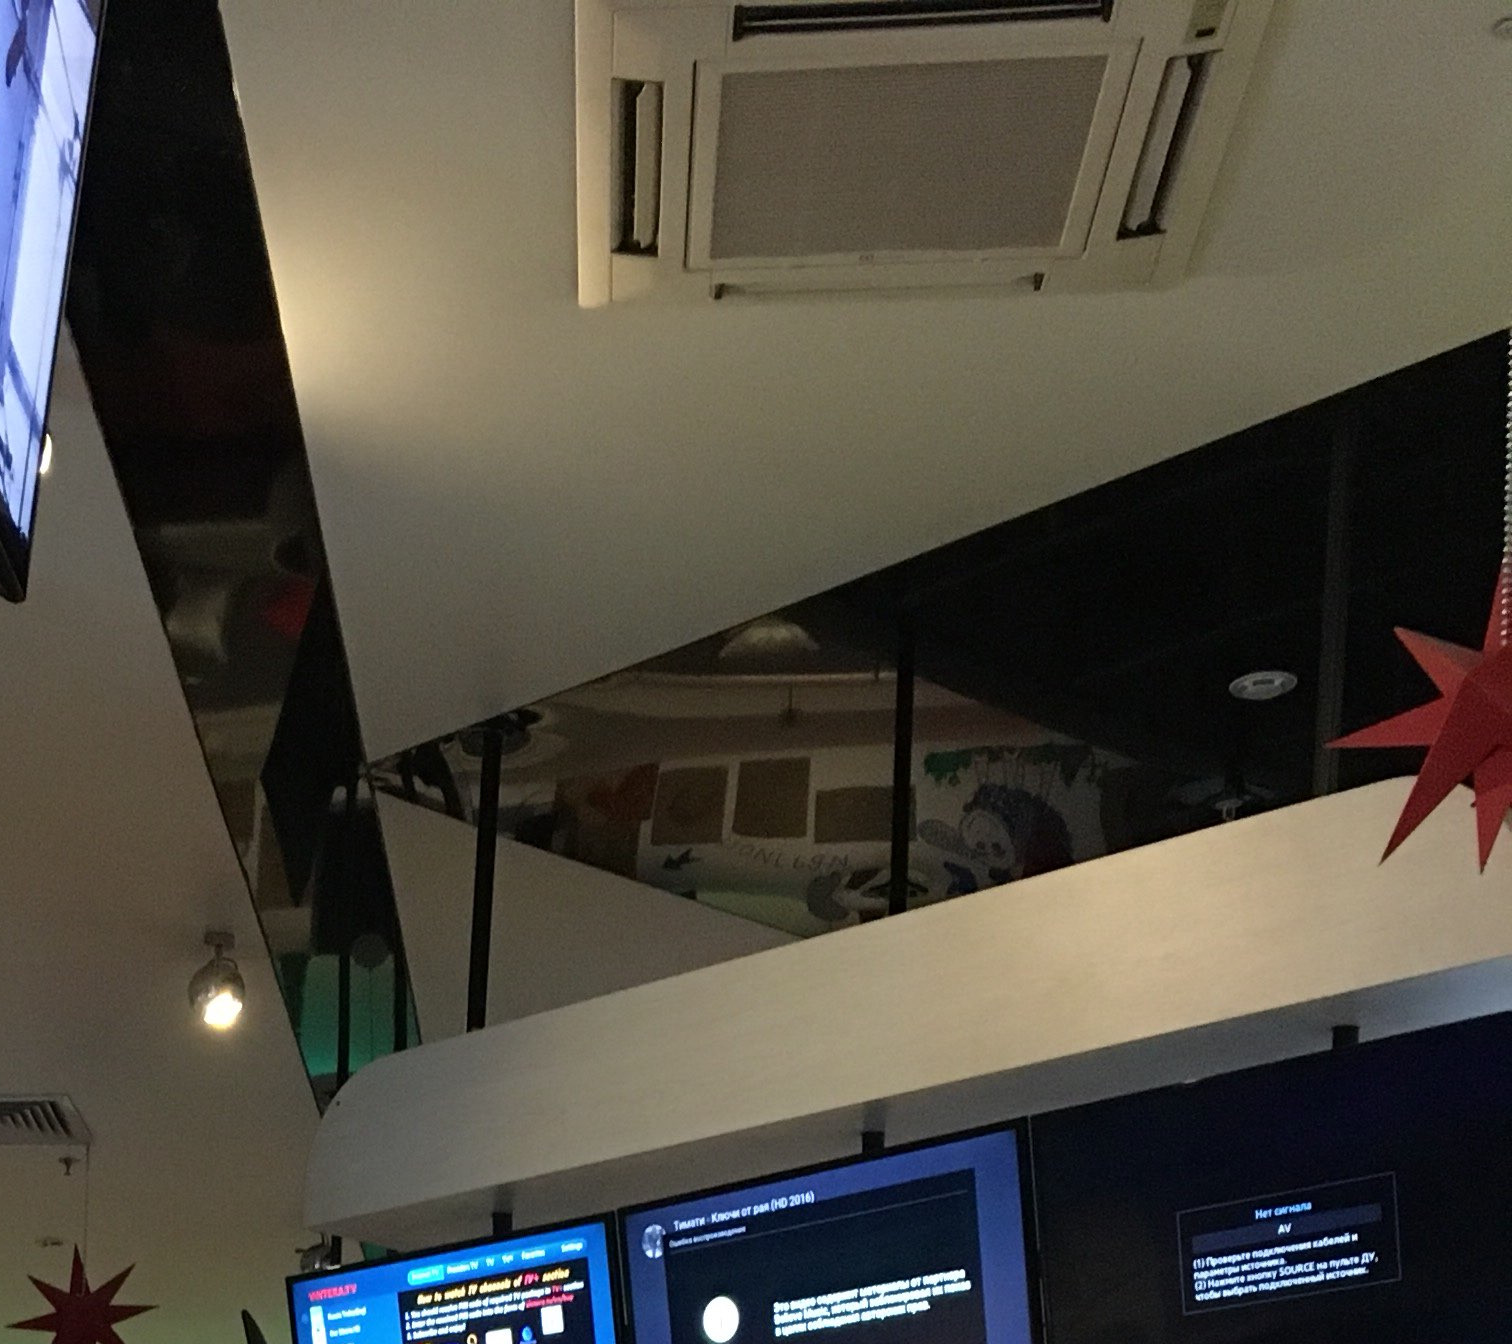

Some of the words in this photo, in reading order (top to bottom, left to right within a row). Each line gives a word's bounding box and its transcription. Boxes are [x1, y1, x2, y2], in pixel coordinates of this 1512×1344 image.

[674, 1216, 705, 1231] Тимати
[711, 1208, 741, 1223] Ключи
[741, 1206, 752, 1217] от
[753, 1202, 770, 1216] рая
[771, 1197, 787, 1212] (HD
[789, 1190, 815, 1207] 2016)
[1255, 1208, 1272, 1220] Нет
[1275, 1201, 1312, 1216] сигнала
[1278, 1223, 1292, 1234] AV
[1193, 1258, 1205, 1270] (1)
[1206, 1252, 1250, 1268] Проверьте
[1252, 1242, 1312, 1261] подключения
[1313, 1233, 1350, 1249] кабелей
[1351, 1233, 1358, 1242] и
[910, 1278, 921, 1288] от
[1194, 1265, 1239, 1281] параметры
[1242, 1258, 1287, 1272] источника.
[1195, 1279, 1206, 1291] (2)
[1208, 1276, 1245, 1288] Нажмите
[1247, 1271, 1277, 1284] кнопку
[1279, 1262, 1315, 1277] SOURCE
[1316, 1261, 1328, 1270] на
[1329, 1256, 1360, 1270] пульте
[1361, 1252, 1378, 1265] ДУ,
[1196, 1289, 1221, 1301] чтобы
[1222, 1284, 1257, 1298] выбрать
[1258, 1272, 1324, 1292] подключенный
[1326, 1267, 1369, 1281] источник.
